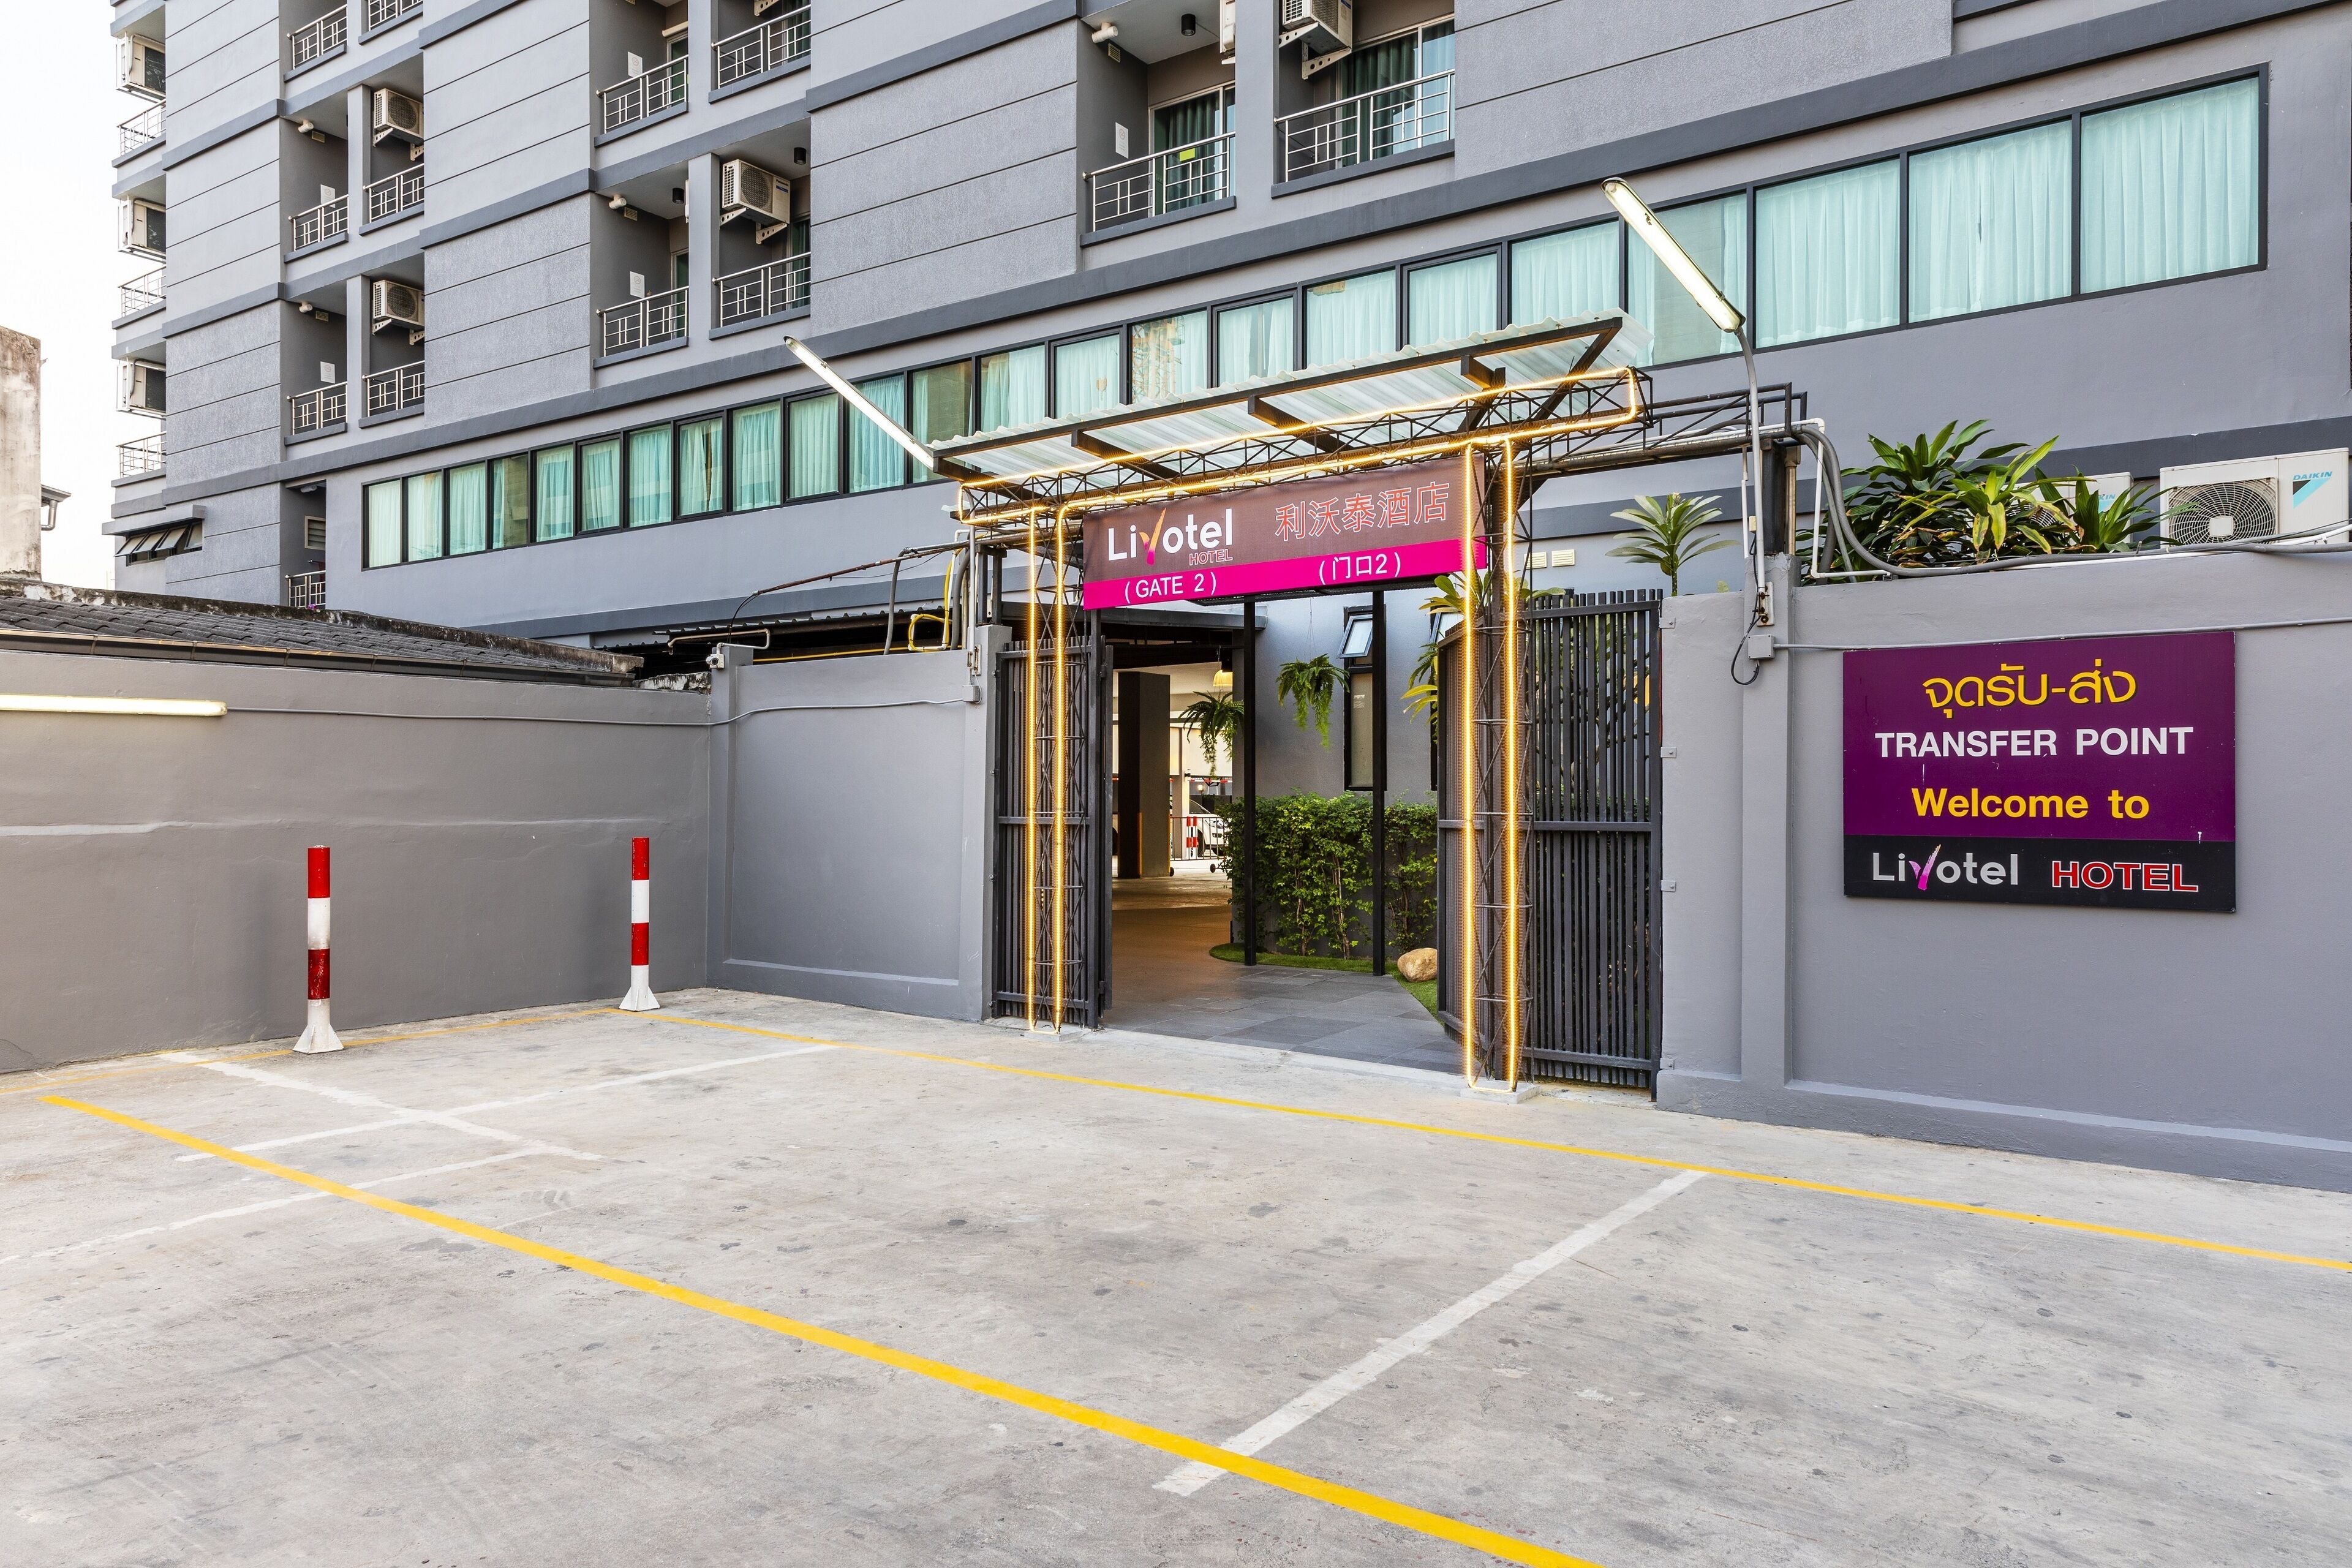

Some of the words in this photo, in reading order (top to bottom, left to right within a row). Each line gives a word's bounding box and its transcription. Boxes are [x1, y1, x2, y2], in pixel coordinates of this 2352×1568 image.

[2293, 471, 2332, 480] DAIKIN
[1275, 481, 1450, 542] 利沃泰酒店
[1188, 549, 1234, 566] HOTEL
[1922, 658, 2137, 719] จุดรับ-ส่ง
[1875, 729, 2057, 758] TRANSFER
[2076, 726, 2194, 756] POINT
[1911, 787, 2089, 818] Welcome
[2108, 790, 2150, 819] to
[2052, 860, 2199, 892] HOTEL
